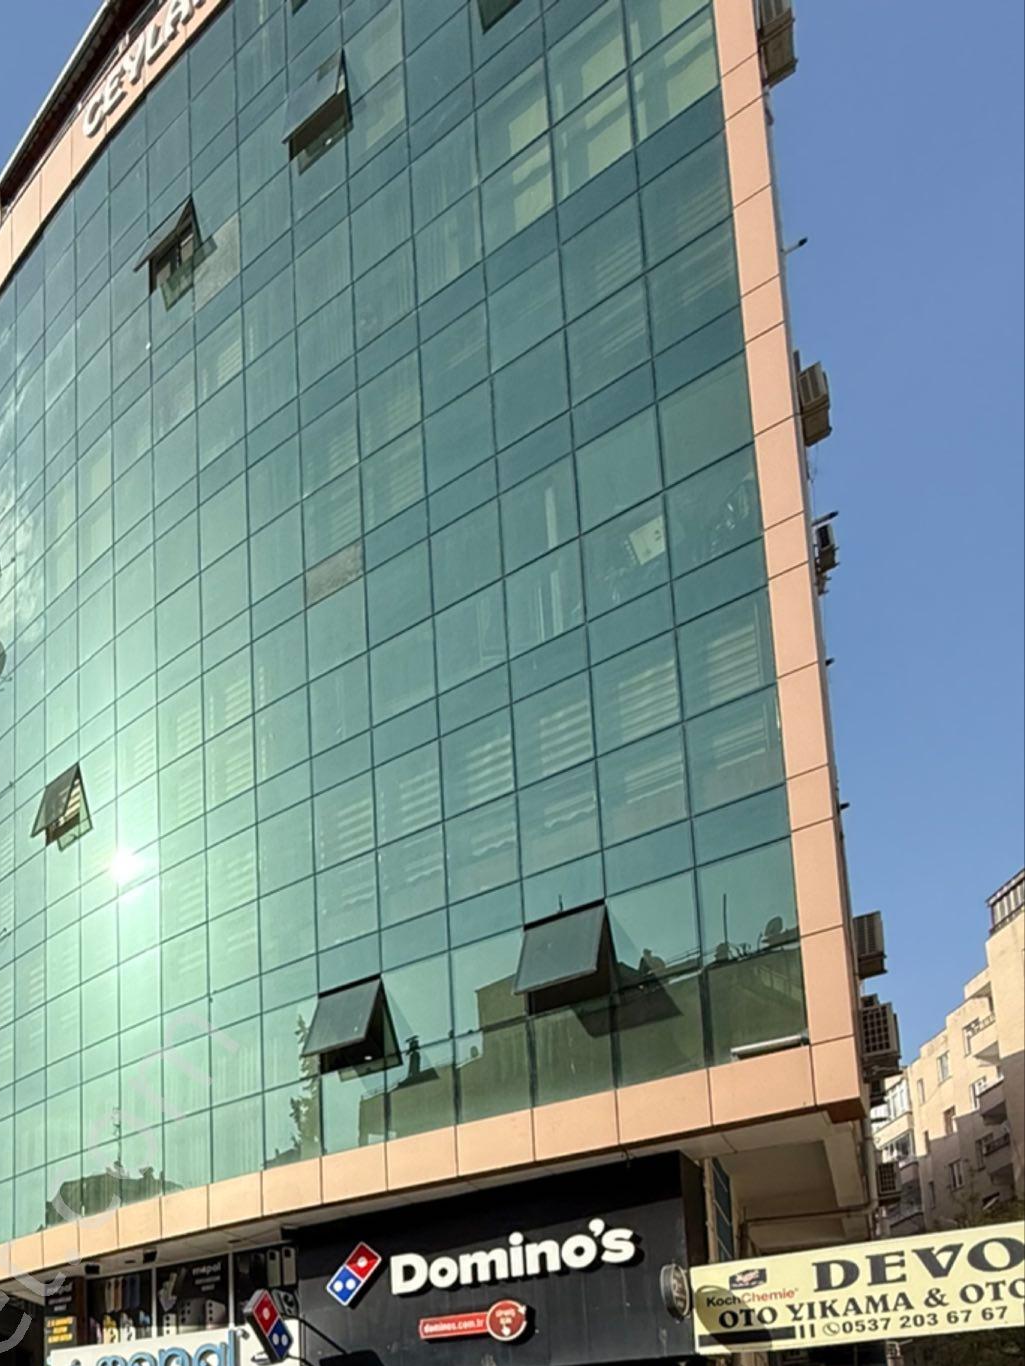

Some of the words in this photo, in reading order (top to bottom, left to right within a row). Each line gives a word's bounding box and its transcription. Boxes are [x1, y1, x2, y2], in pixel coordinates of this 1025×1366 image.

[389, 1217, 636, 1295] Domino's
[812, 1236, 1025, 1293] DEVO
[706, 1287, 797, 1308] KochChemie
[719, 1306, 777, 1329] OTO
[786, 1291, 914, 1322] YIKAMA
[925, 1287, 949, 1308] &
[842, 1318, 891, 1334] 0537
[899, 1313, 939, 1330] 203
[947, 1309, 972, 1325] 67
[981, 1305, 1009, 1321] 67
